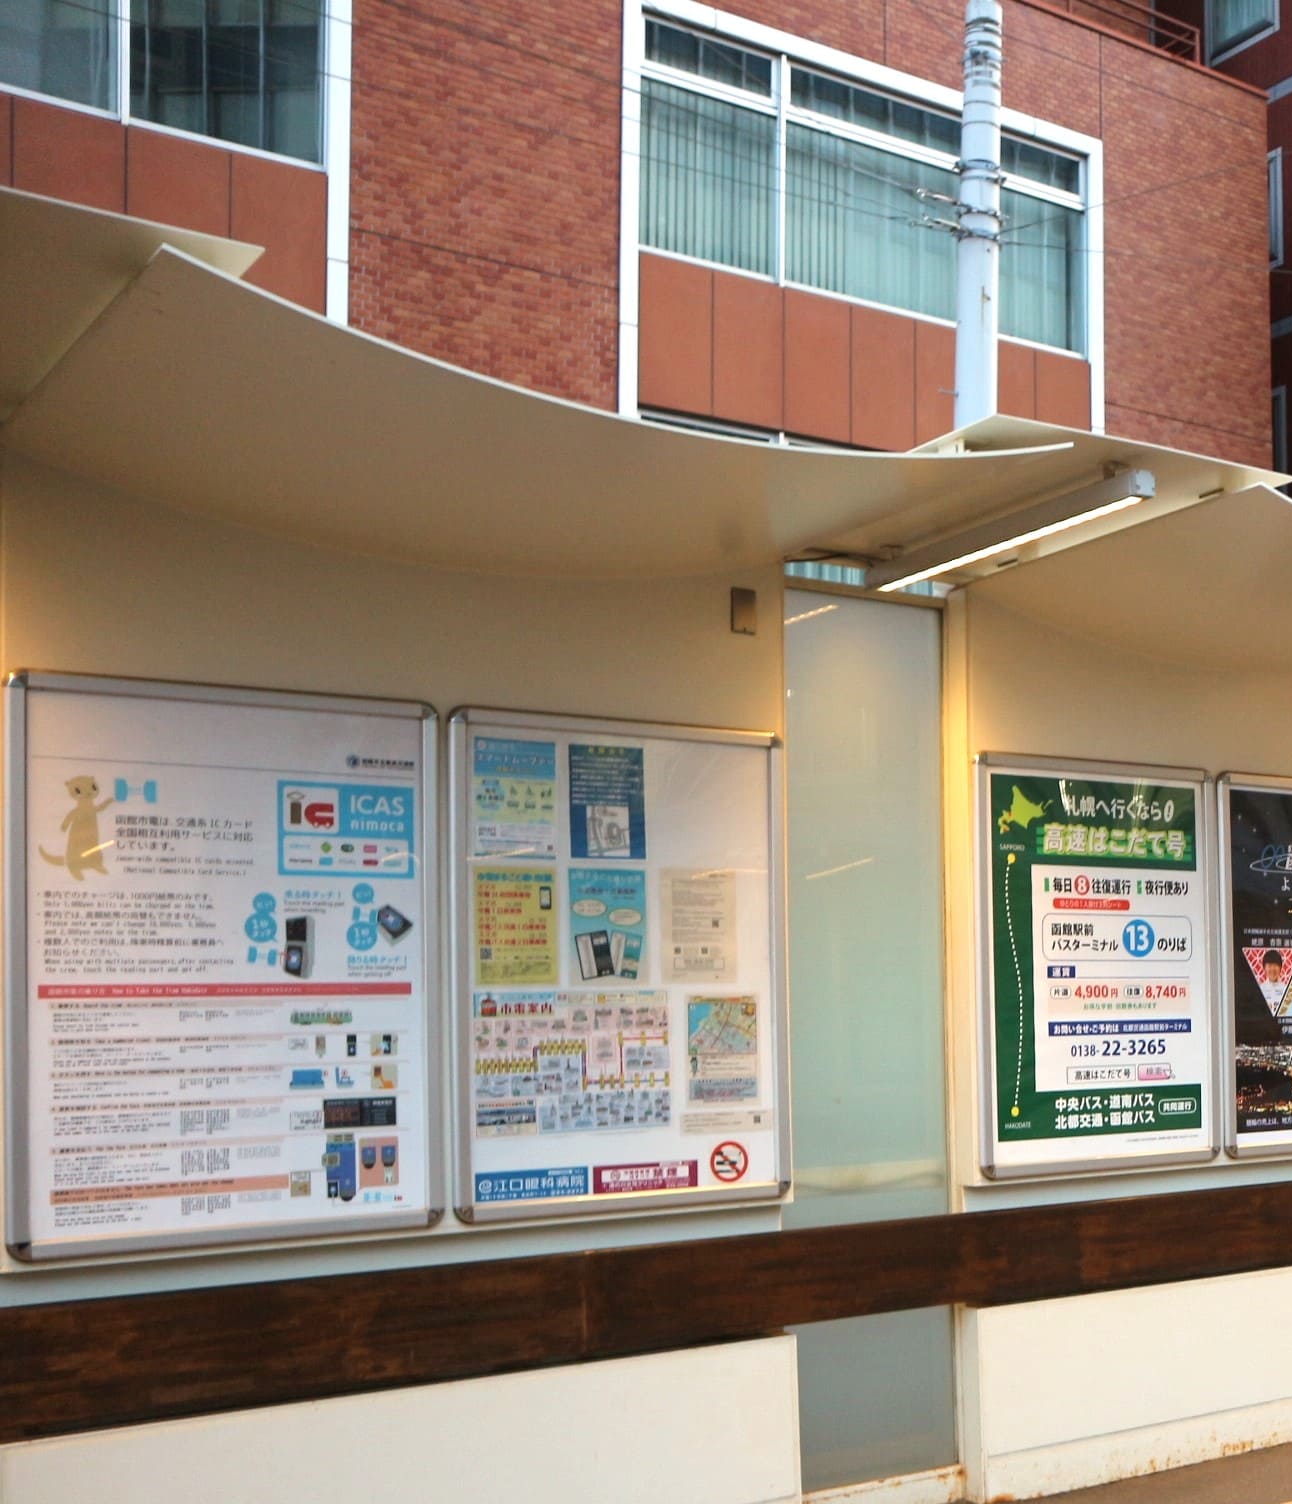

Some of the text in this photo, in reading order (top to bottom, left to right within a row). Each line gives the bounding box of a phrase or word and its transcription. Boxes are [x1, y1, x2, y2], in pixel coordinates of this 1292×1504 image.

[350, 795, 405, 817] ICAS
[350, 819, 404, 833] nimoca
[1044, 823, 1186, 859] 高速はこだて号
[1144, 880, 1189, 896] 夜行便あり
[1051, 923, 1094, 937] 函館駅前
[1052, 924, 1187, 953] バスターミナル 13 のりば
[1074, 985, 1119, 999] 4,900円
[1145, 985, 1187, 998] 8,740円
[1071, 1039, 1167, 1057] 0138-22-3265
[1074, 1068, 1131, 1081] 高速はこだて号
[1054, 1093, 1155, 1112] 中央バス・道南バス
[1054, 1111, 1156, 1130] 北都交通・函館バス
